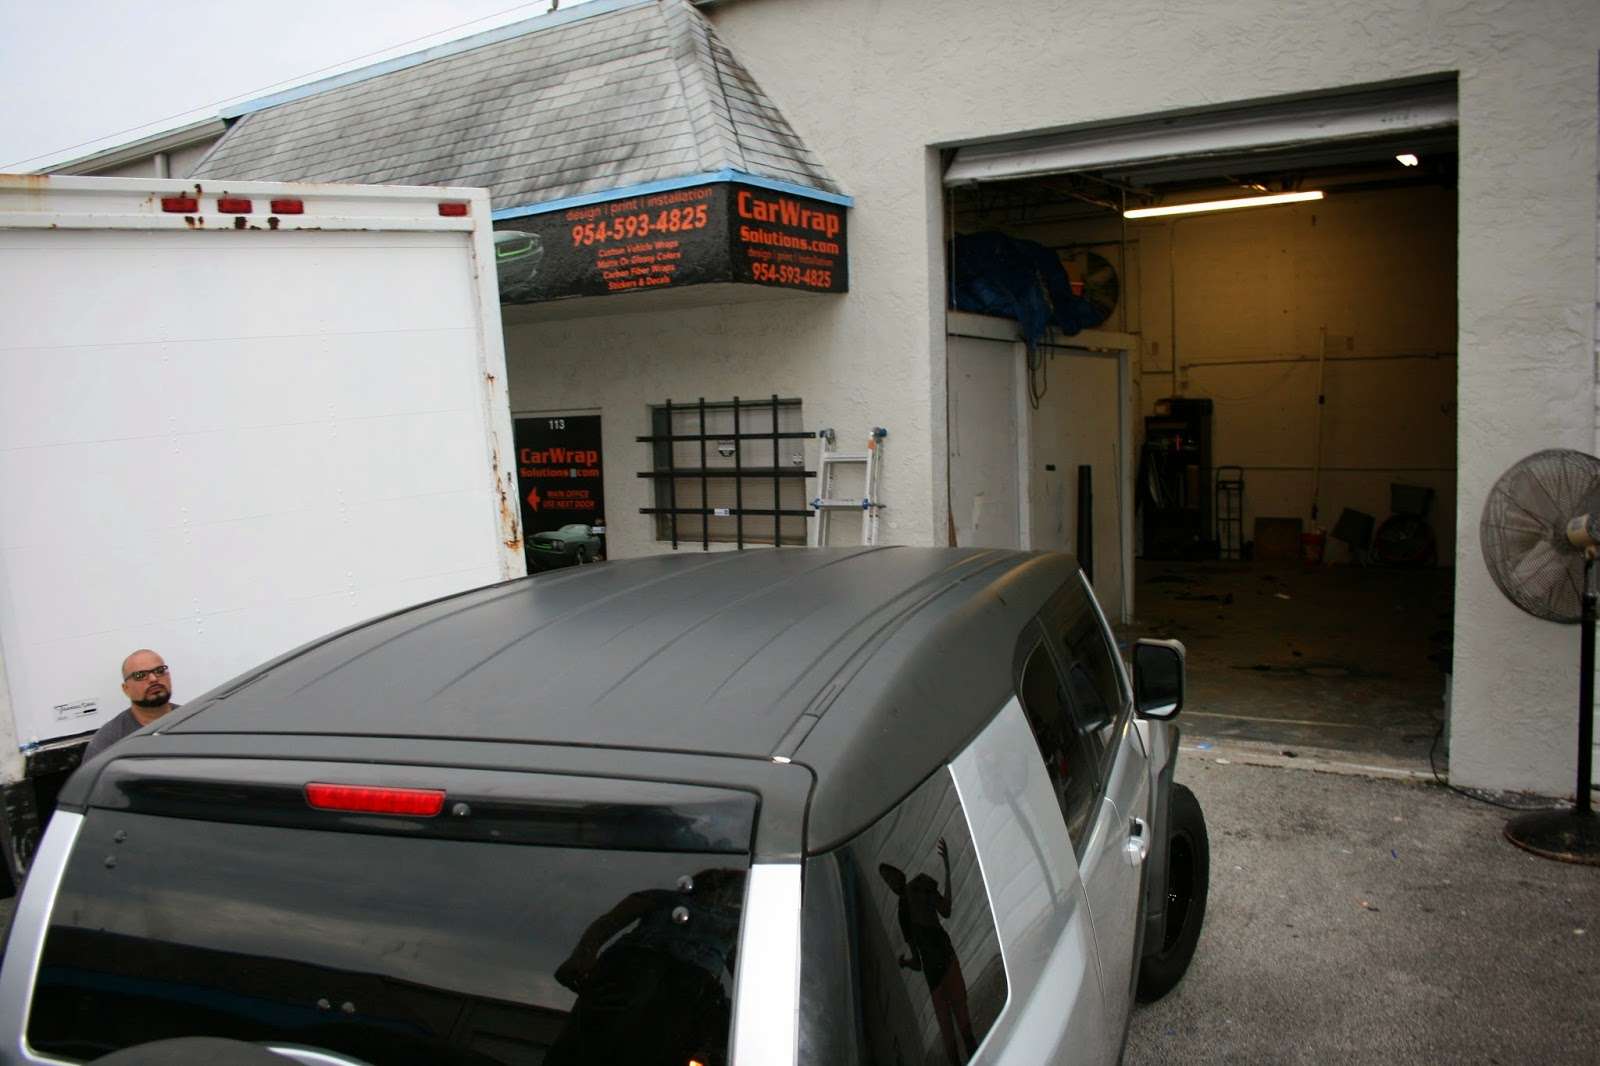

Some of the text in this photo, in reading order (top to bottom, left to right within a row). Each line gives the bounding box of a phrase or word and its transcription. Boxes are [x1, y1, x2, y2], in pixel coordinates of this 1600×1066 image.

[610, 200, 637, 216] print
[647, 188, 713, 207] installation
[736, 190, 840, 238] CarWrap
[571, 203, 709, 247] 954-593-4825
[739, 224, 840, 255] Solutions.com
[752, 262, 831, 288] 954-593-4825
[548, 419, 566, 430] 113
[520, 447, 598, 467] CarWrap
